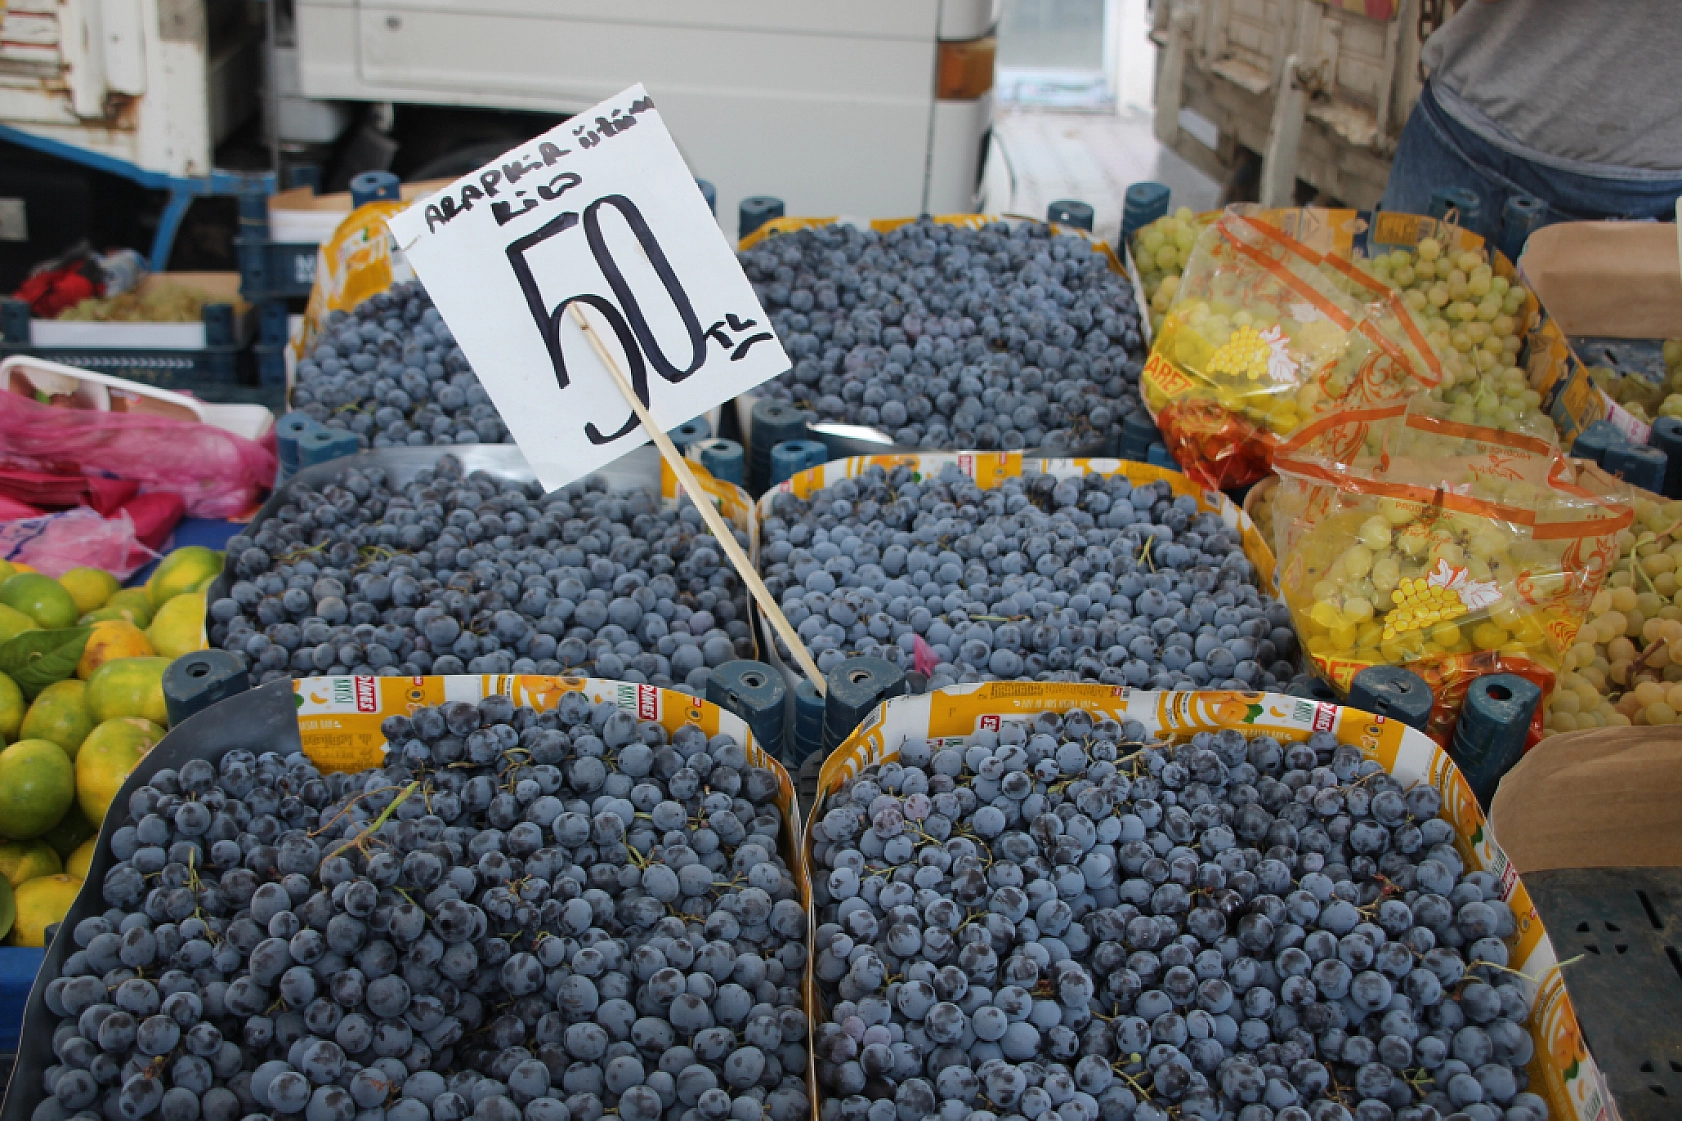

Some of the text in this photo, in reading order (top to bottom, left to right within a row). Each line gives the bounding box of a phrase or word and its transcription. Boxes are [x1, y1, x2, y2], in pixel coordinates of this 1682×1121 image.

[505, 194, 758, 445] 50 TL
[1143, 350, 1192, 395] ARET
